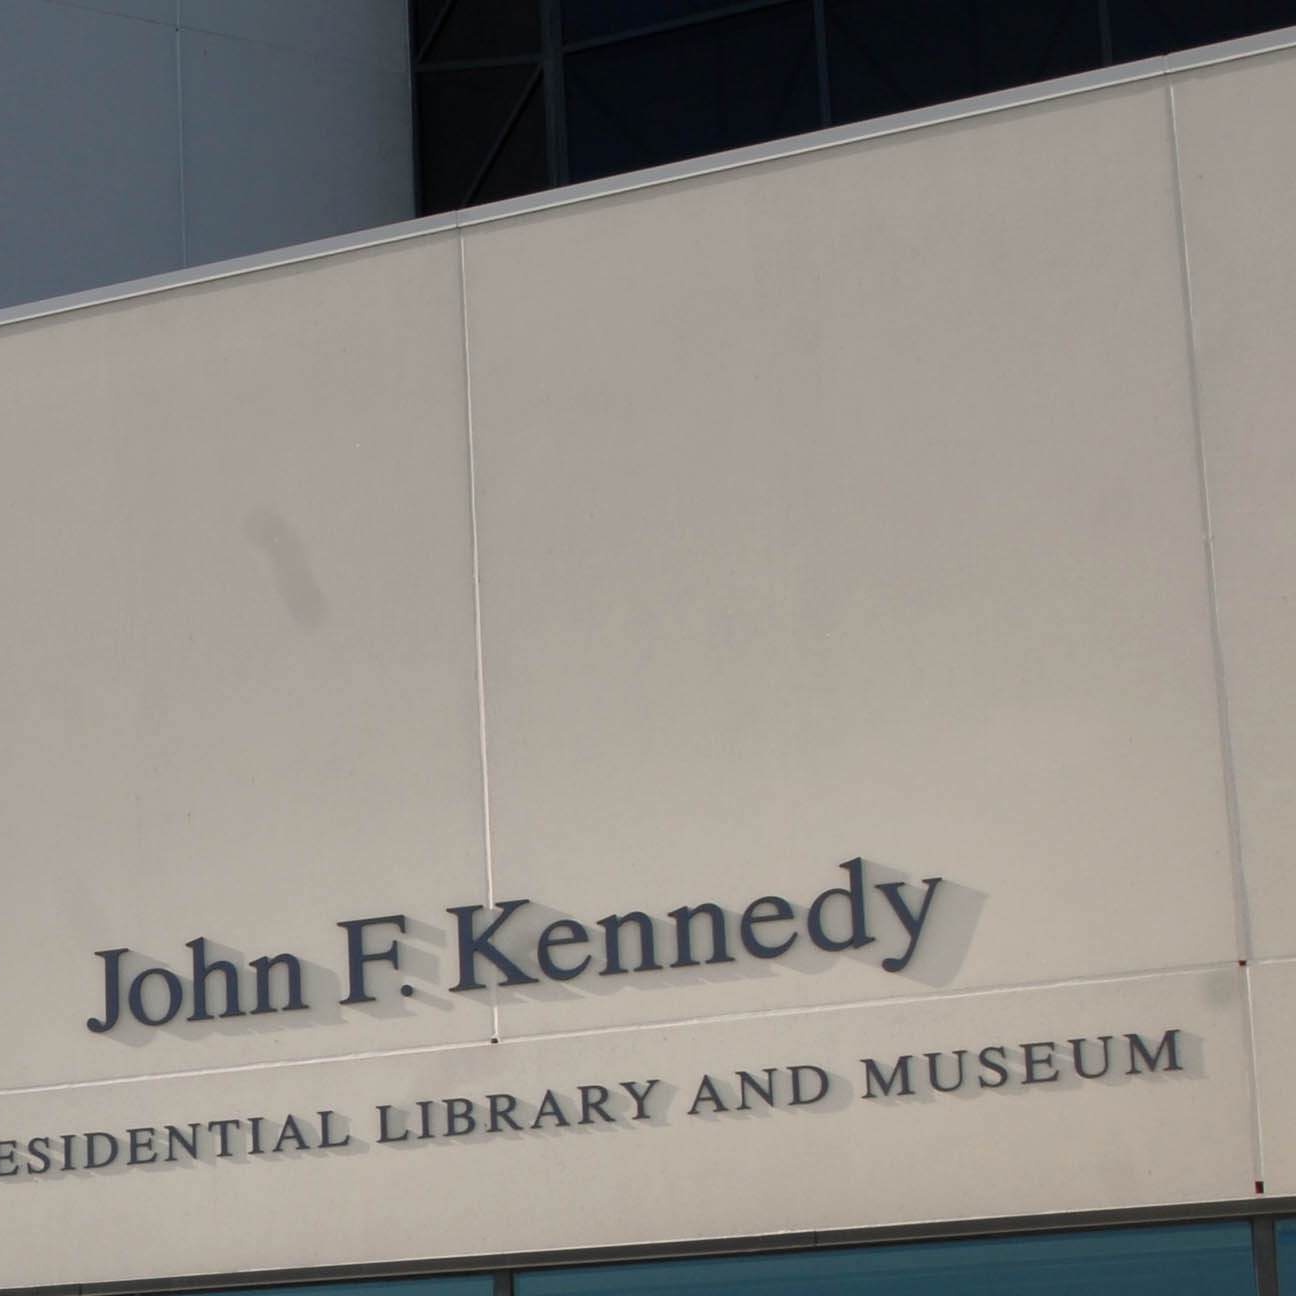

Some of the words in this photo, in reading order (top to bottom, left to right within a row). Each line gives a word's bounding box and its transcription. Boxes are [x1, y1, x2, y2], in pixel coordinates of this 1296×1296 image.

[87, 937, 309, 1033] John
[337, 915, 414, 1005] F.
[447, 857, 942, 992] Kennedy
[376, 1080, 660, 1144] LIBRARY
[688, 1065, 830, 1114] AND
[861, 1030, 1184, 1099] MUSEUM
